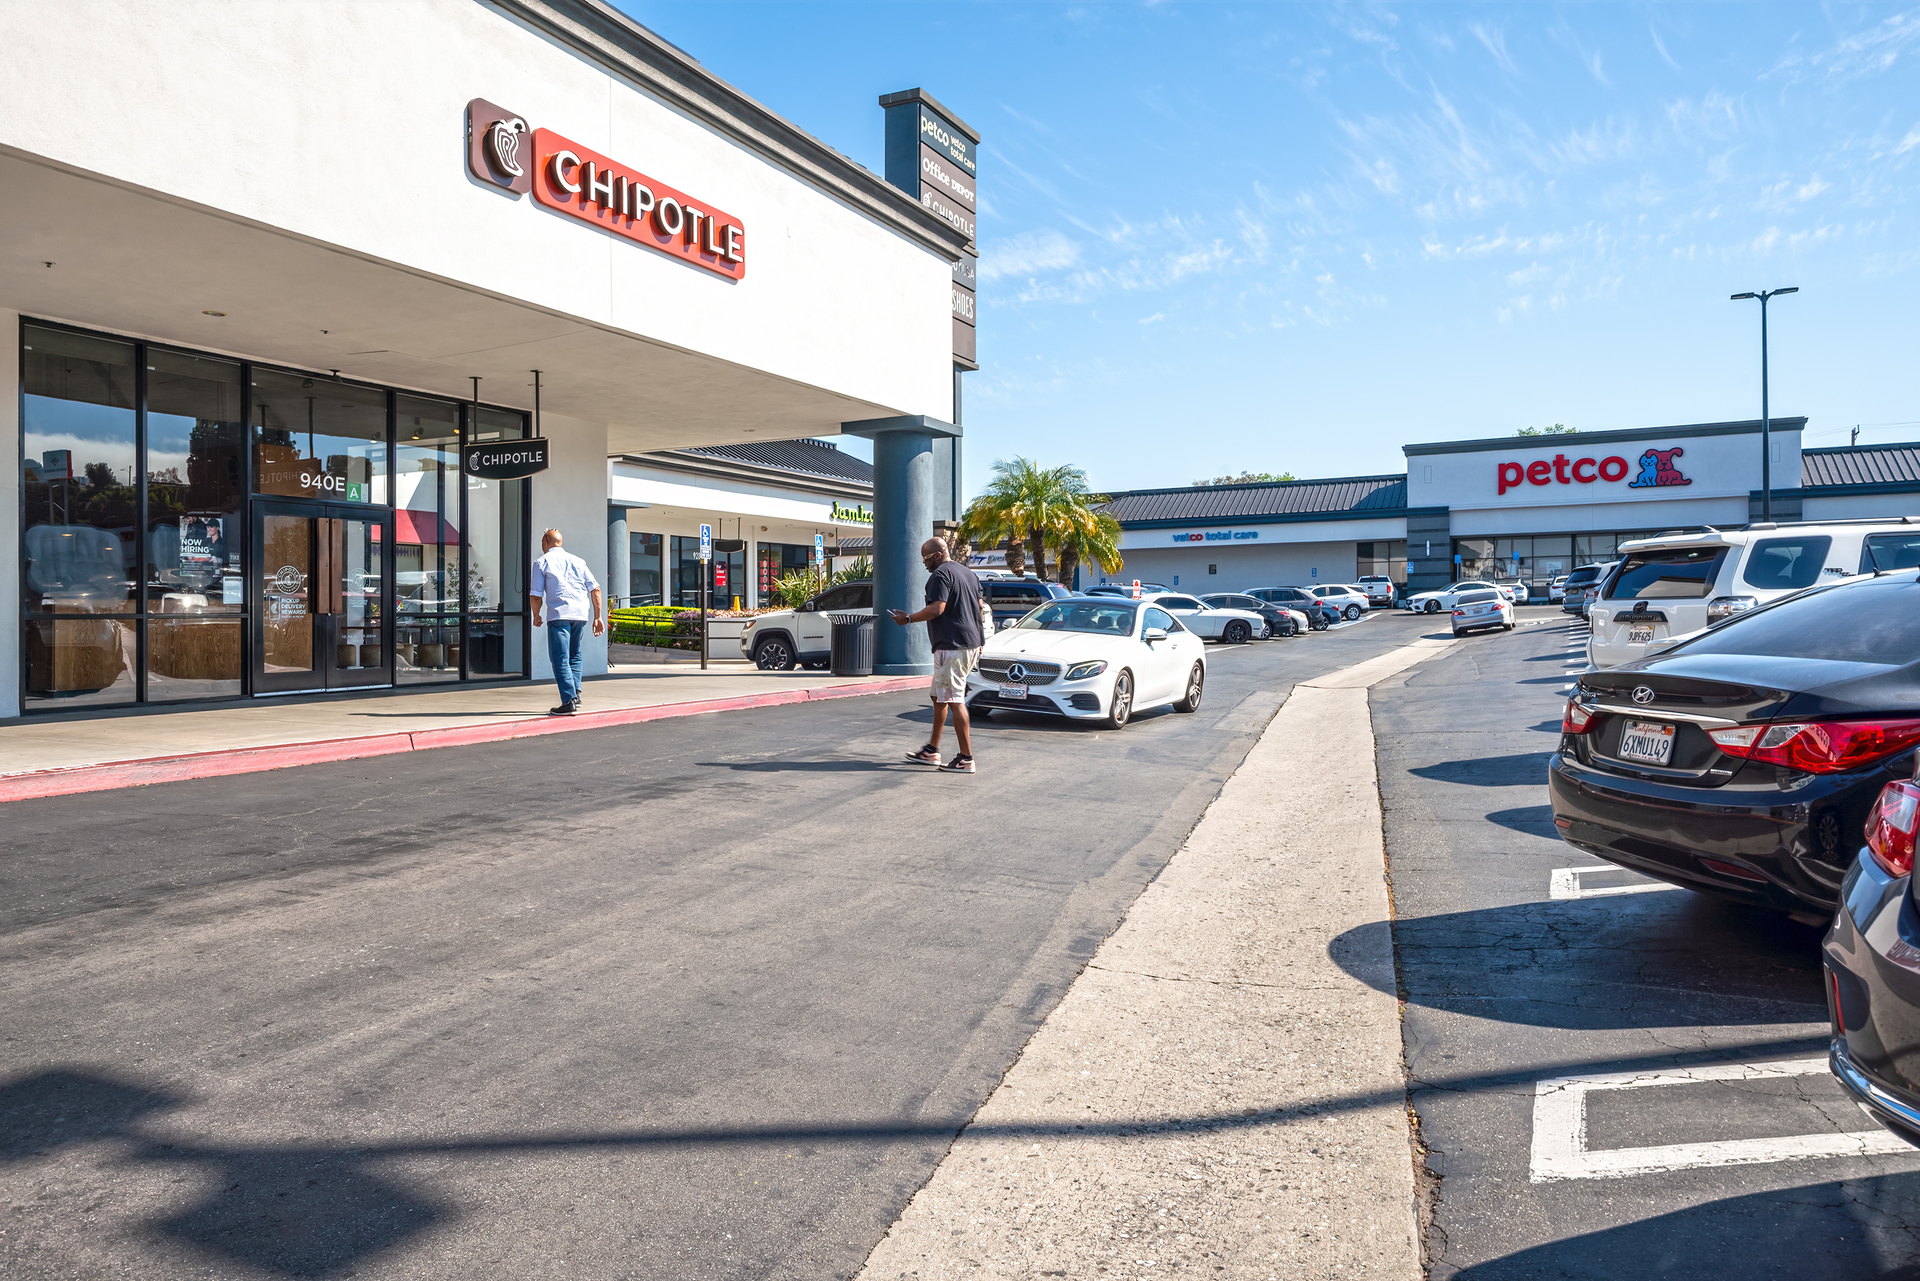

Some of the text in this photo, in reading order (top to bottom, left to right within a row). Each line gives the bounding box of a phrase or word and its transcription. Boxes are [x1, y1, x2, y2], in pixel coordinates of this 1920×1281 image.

[921, 114, 950, 148] petco
[950, 135, 966, 153] vetco
[950, 145, 976, 172] total care
[922, 157, 975, 203] Office DEPOT
[549, 149, 744, 264] CHIPOTLE
[952, 289, 974, 320] SHOES
[482, 450, 543, 466] CHIPOTLE
[300, 472, 346, 492] 940E
[1498, 454, 1628, 495] petco
[349, 486, 359, 499] A
[181, 538, 203, 546] NOW
[1172, 529, 1259, 543] vetco total care
[181, 545, 210, 554] HIRING
[1628, 631, 1652, 642] 9JPF625
[1634, 722, 1666, 736] California
[1622, 734, 1670, 758] 6XMU149
